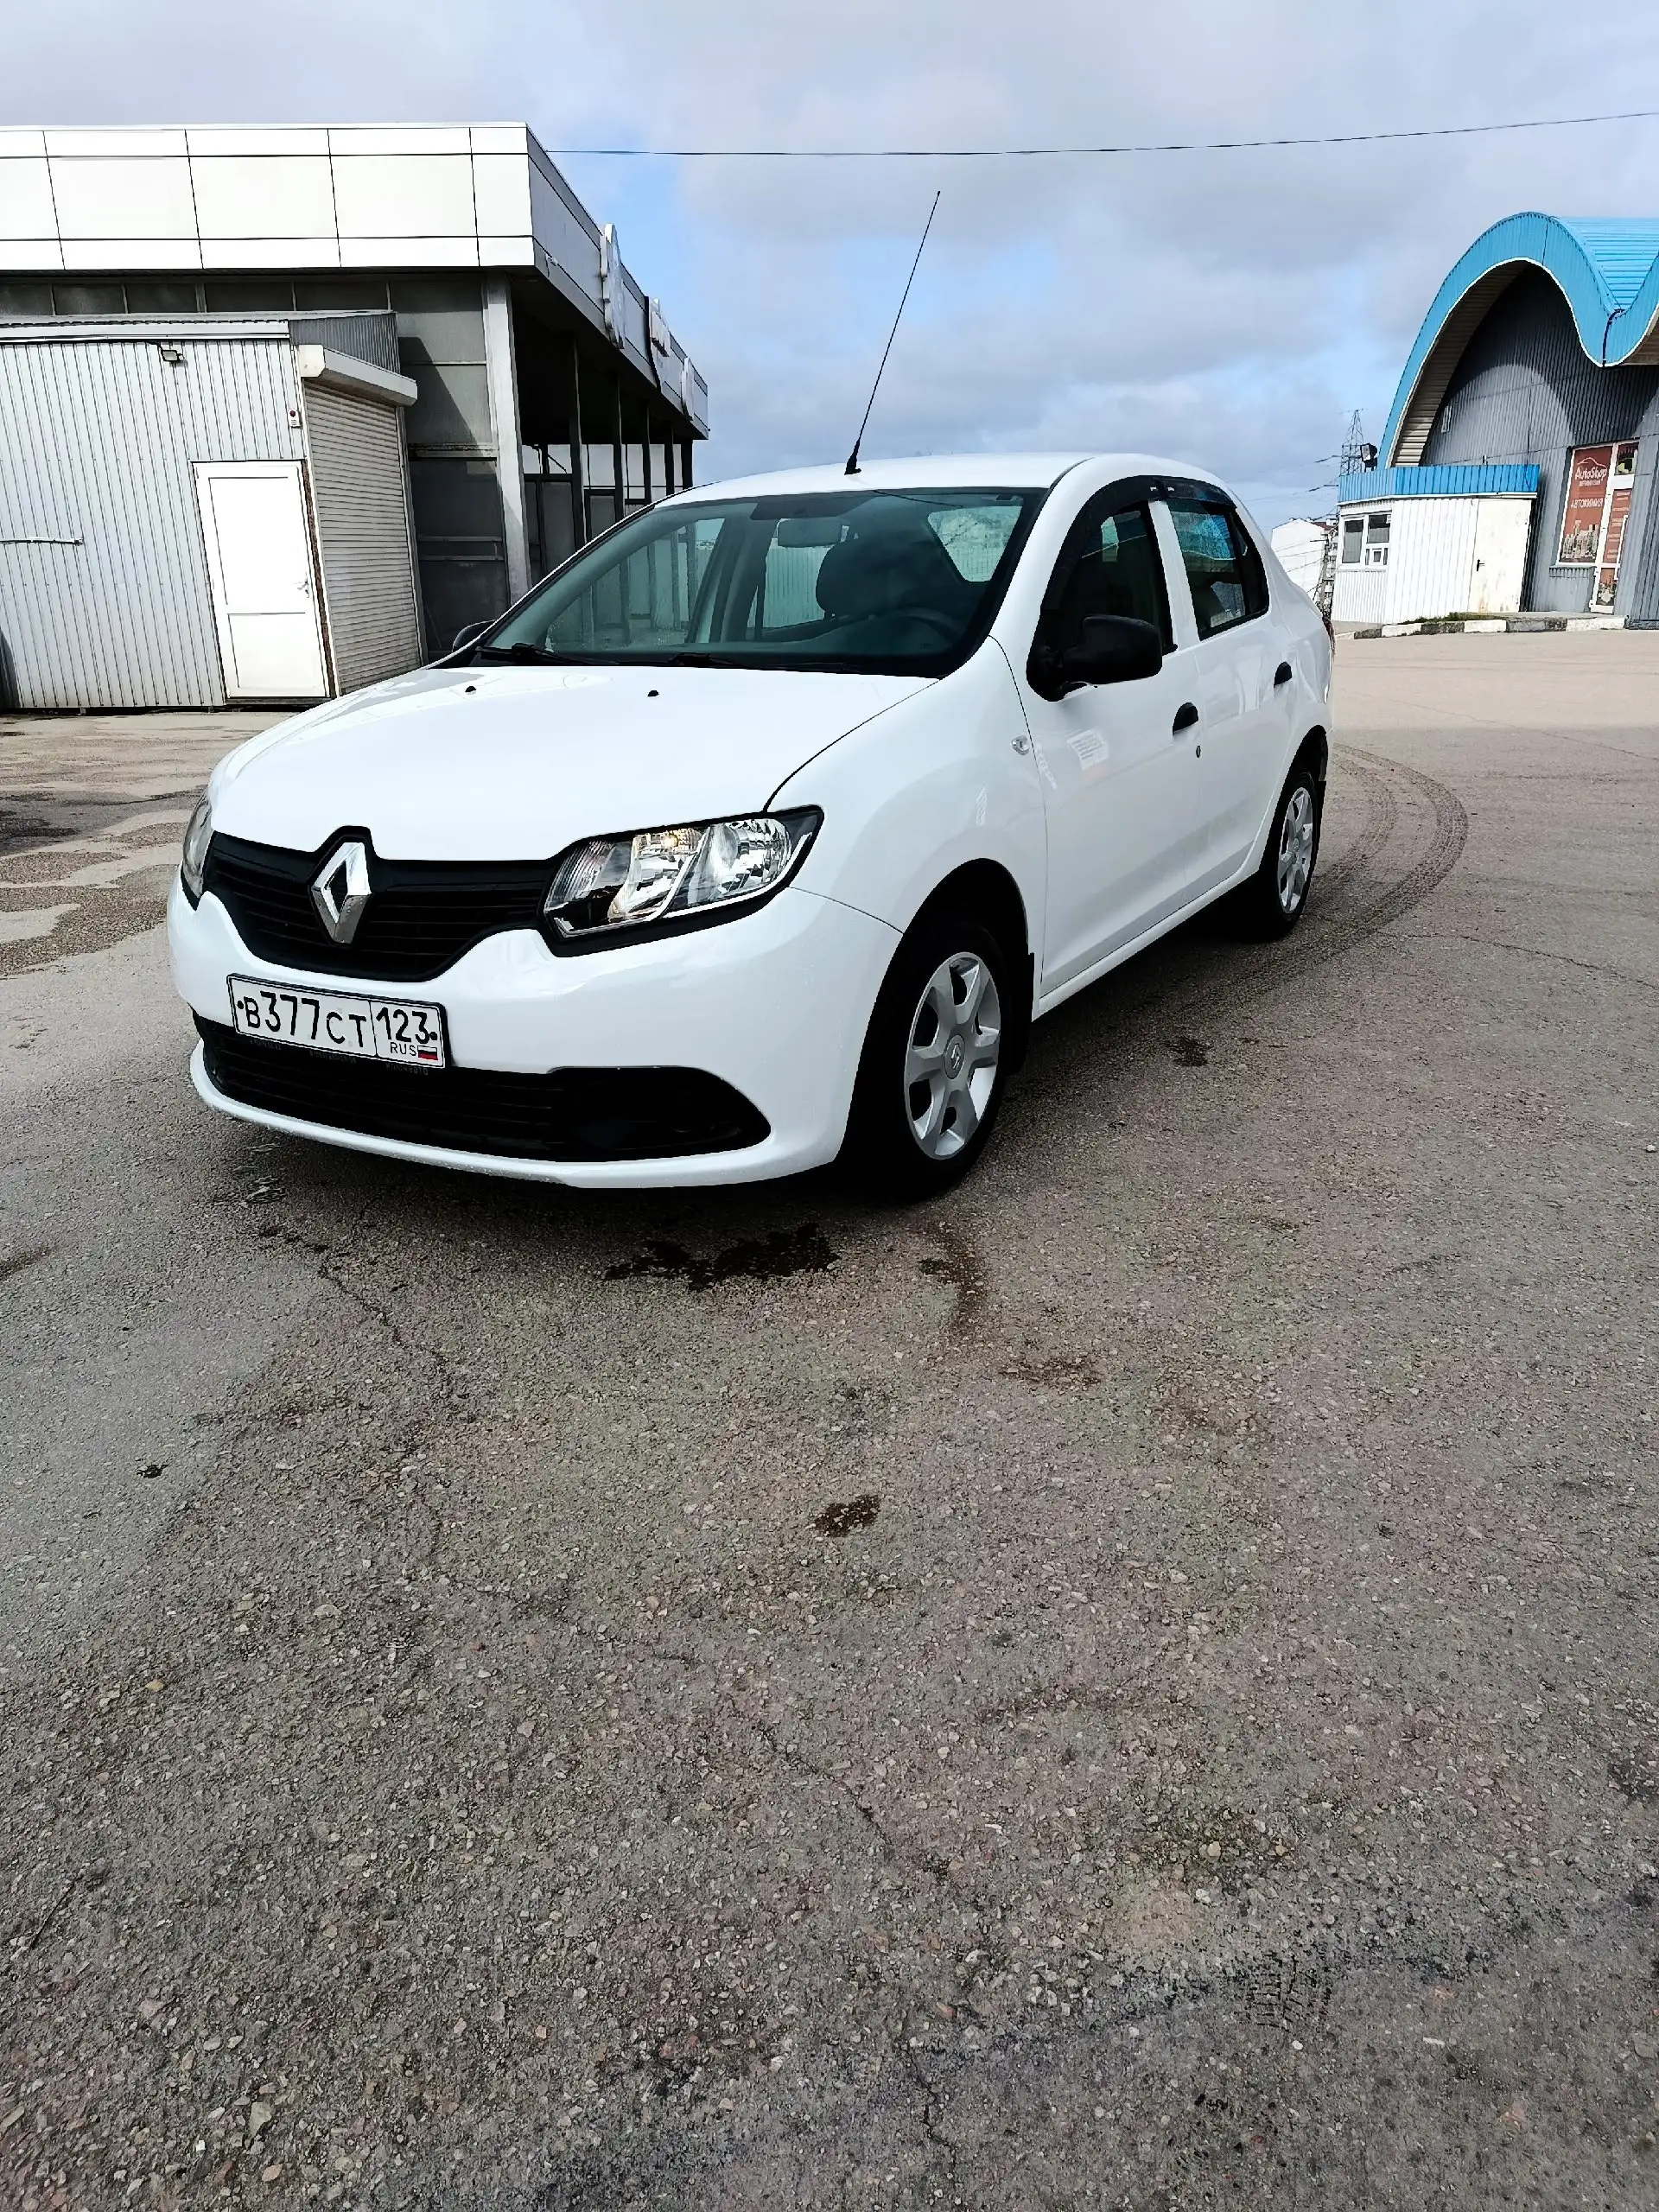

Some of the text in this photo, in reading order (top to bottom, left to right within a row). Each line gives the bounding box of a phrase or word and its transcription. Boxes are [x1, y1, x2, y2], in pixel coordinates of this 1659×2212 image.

[1574, 467, 1607, 481] AutoShop
[375, 1006, 430, 1045] 123
[390, 1041, 416, 1057] RUS
